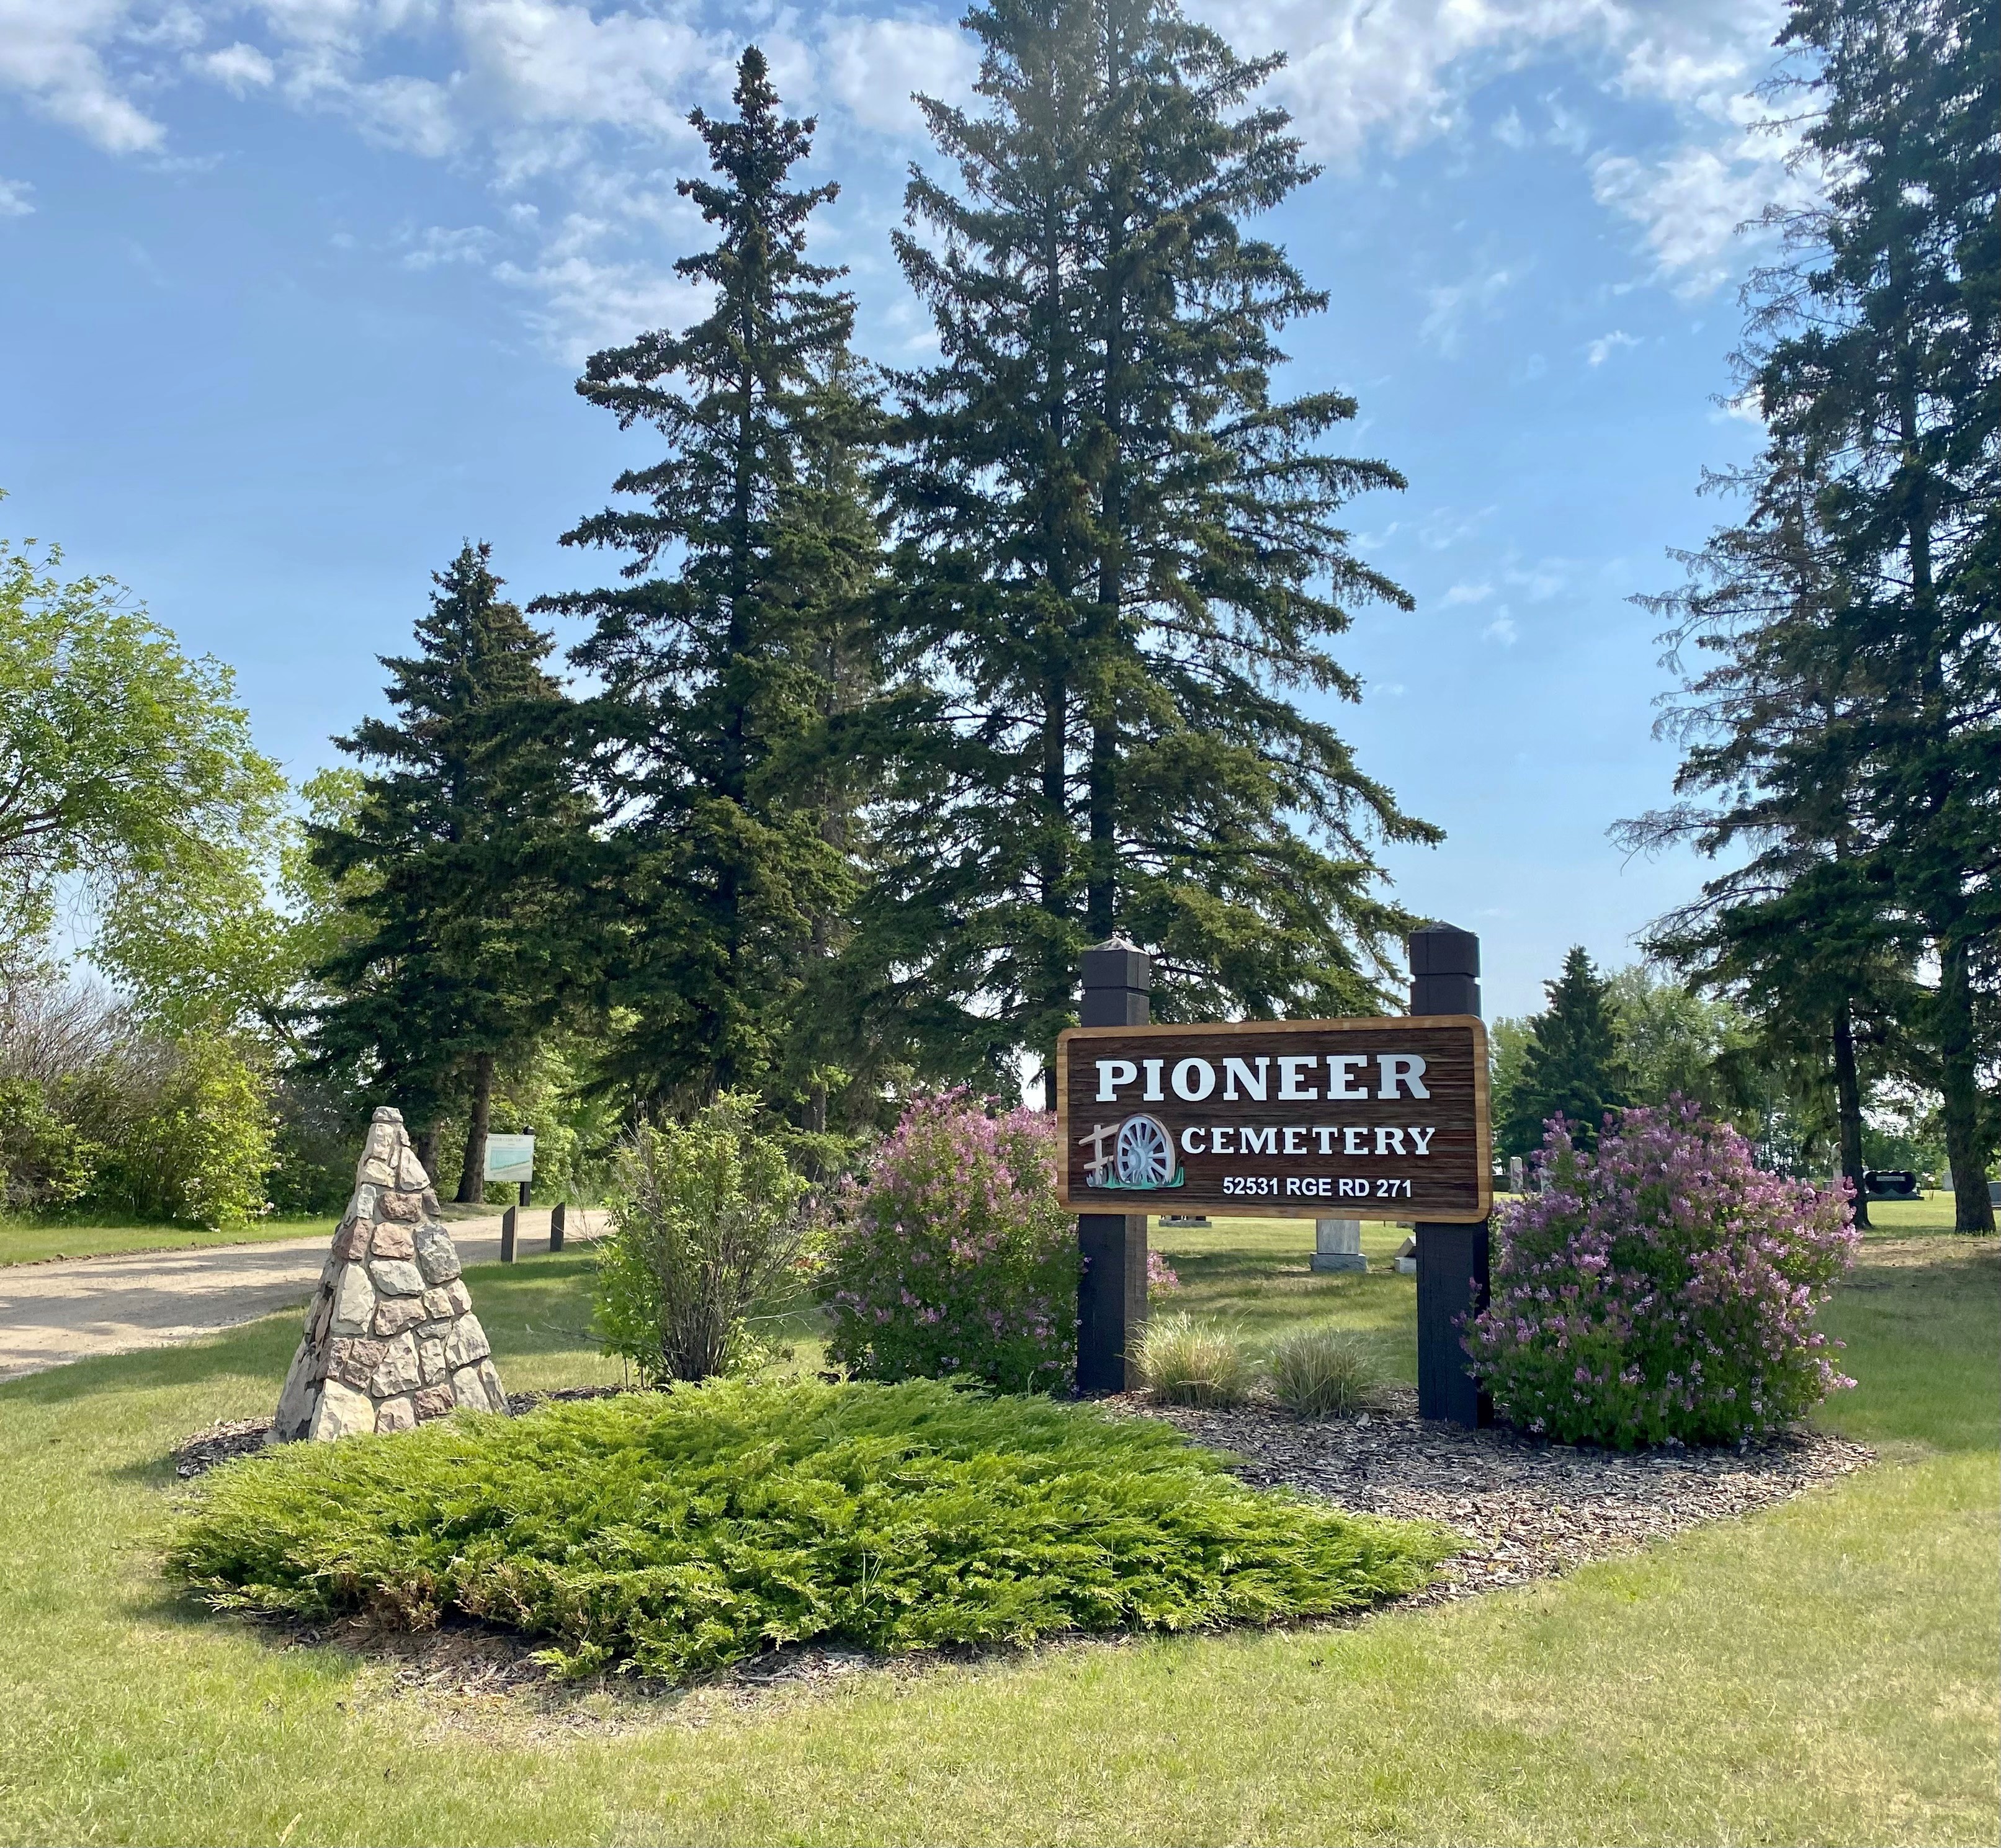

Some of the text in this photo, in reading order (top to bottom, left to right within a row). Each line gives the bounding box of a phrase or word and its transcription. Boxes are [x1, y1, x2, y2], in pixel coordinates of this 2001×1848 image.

[1095, 1054, 1430, 1102] PIONEER
[1181, 1127, 1435, 1155] CEMETERY
[1223, 1177, 1411, 1198] 52531 RGE RD 271
